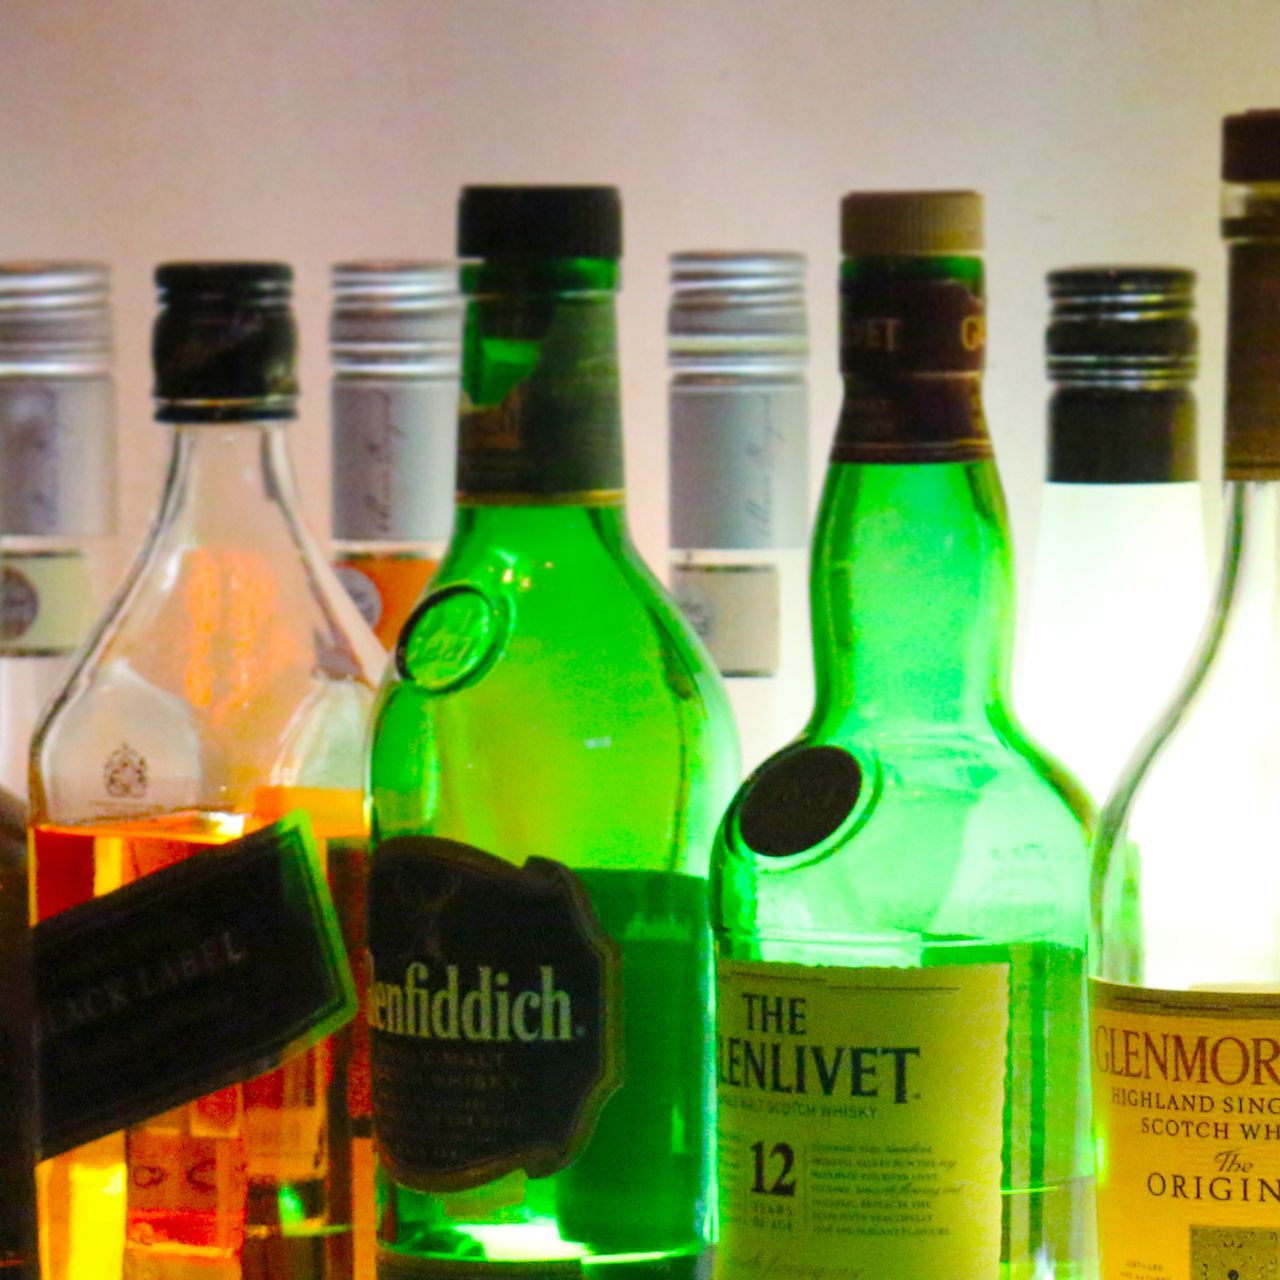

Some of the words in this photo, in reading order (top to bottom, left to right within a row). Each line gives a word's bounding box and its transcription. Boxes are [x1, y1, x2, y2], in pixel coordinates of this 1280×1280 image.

[742, 993, 807, 1036] THE
[1111, 1088, 1215, 1113] HIGHLAND
[1141, 1117, 1229, 1140] SCOTCH
[750, 1139, 796, 1197] 12
[1214, 1149, 1254, 1173] The
